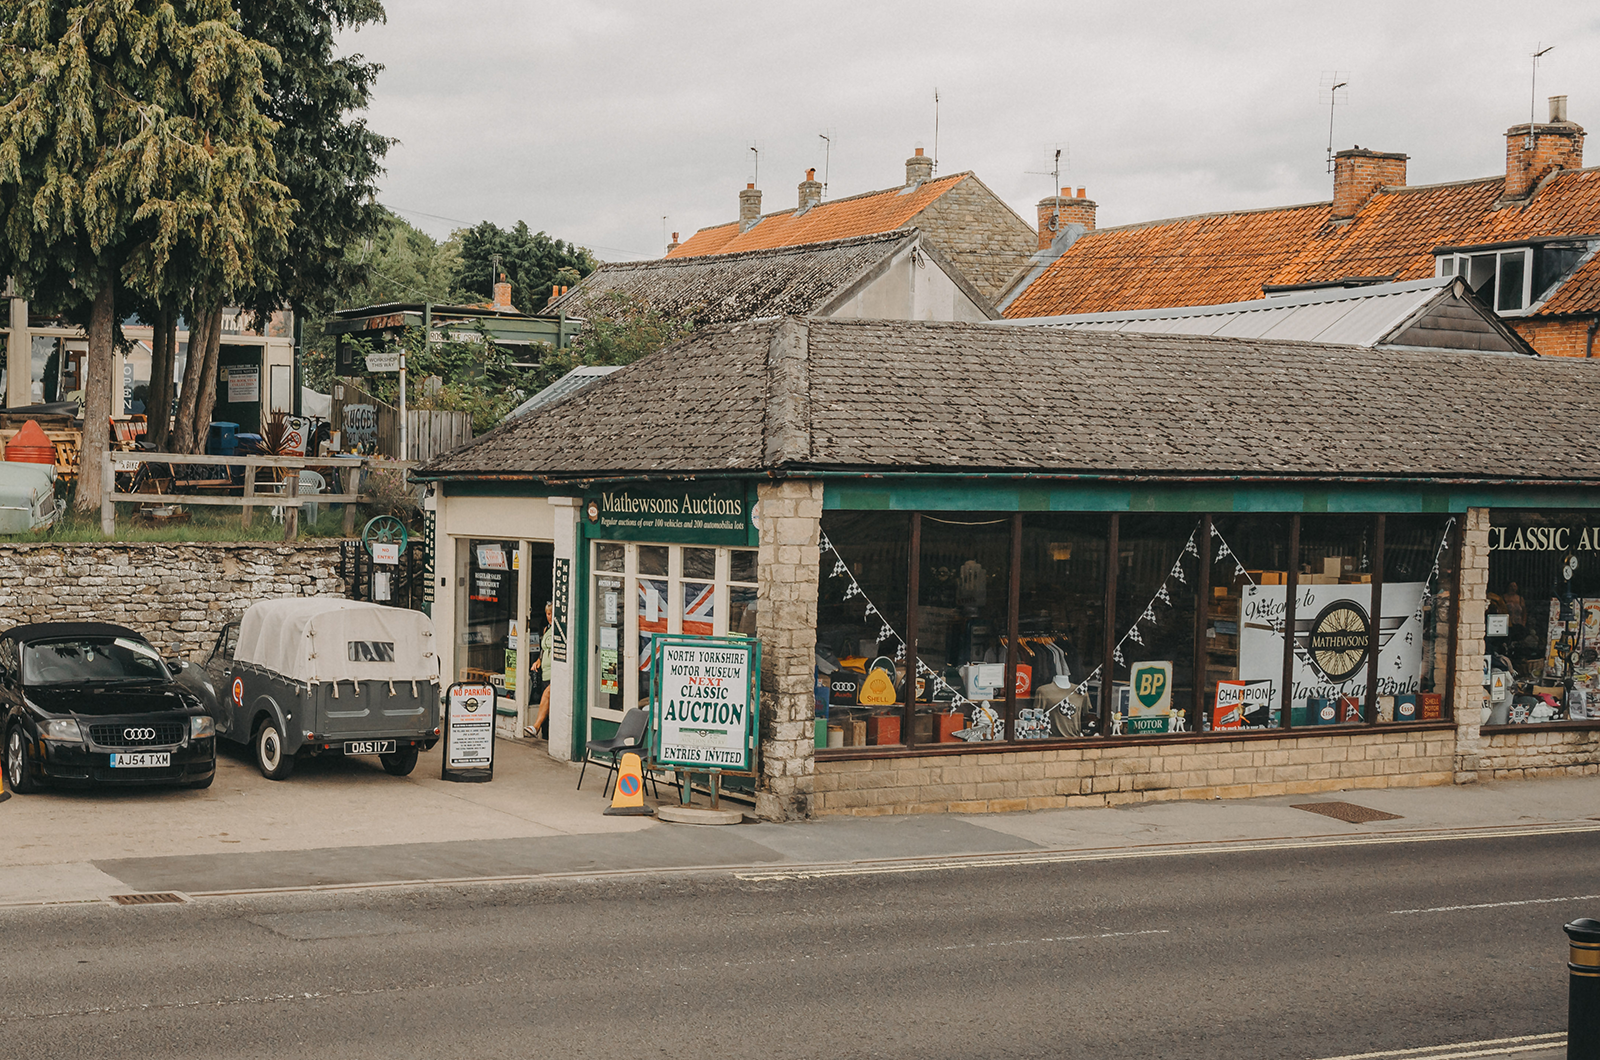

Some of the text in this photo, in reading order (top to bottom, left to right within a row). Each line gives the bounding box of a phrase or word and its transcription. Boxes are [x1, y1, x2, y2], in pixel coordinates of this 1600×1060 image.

[602, 492, 742, 516] Mathewsons Auctions
[601, 517, 618, 528] Regular
[618, 518, 637, 527] auctions
[637, 517, 643, 528] of
[654, 519, 664, 527] 100
[664, 519, 683, 528] vehicles
[684, 519, 693, 528] and
[693, 520, 703, 529] 200
[703, 520, 733, 530] automobilia
[734, 520, 744, 530] lots
[1488, 526, 1570, 551] CLASSIC
[560, 564, 568, 623] MUSEUM
[1245, 588, 1315, 621] Wlcoe to
[1311, 635, 1369, 648] MATHEWSONS
[667, 650, 745, 664] NORTH YORKSHIRE
[670, 665, 741, 679] MOTOR MUSEUM
[688, 676, 723, 686] NEXT
[1139, 673, 1164, 696] BP
[453, 688, 491, 696] NO PARKING
[680, 685, 729, 700] CLASSIC
[1292, 681, 1336, 700] lassic
[664, 699, 744, 725] AUCTION
[1133, 719, 1163, 729] MOTOR
[118, 754, 168, 765] AJ54 TXM
[664, 747, 742, 764] ENTRIES INVITED
